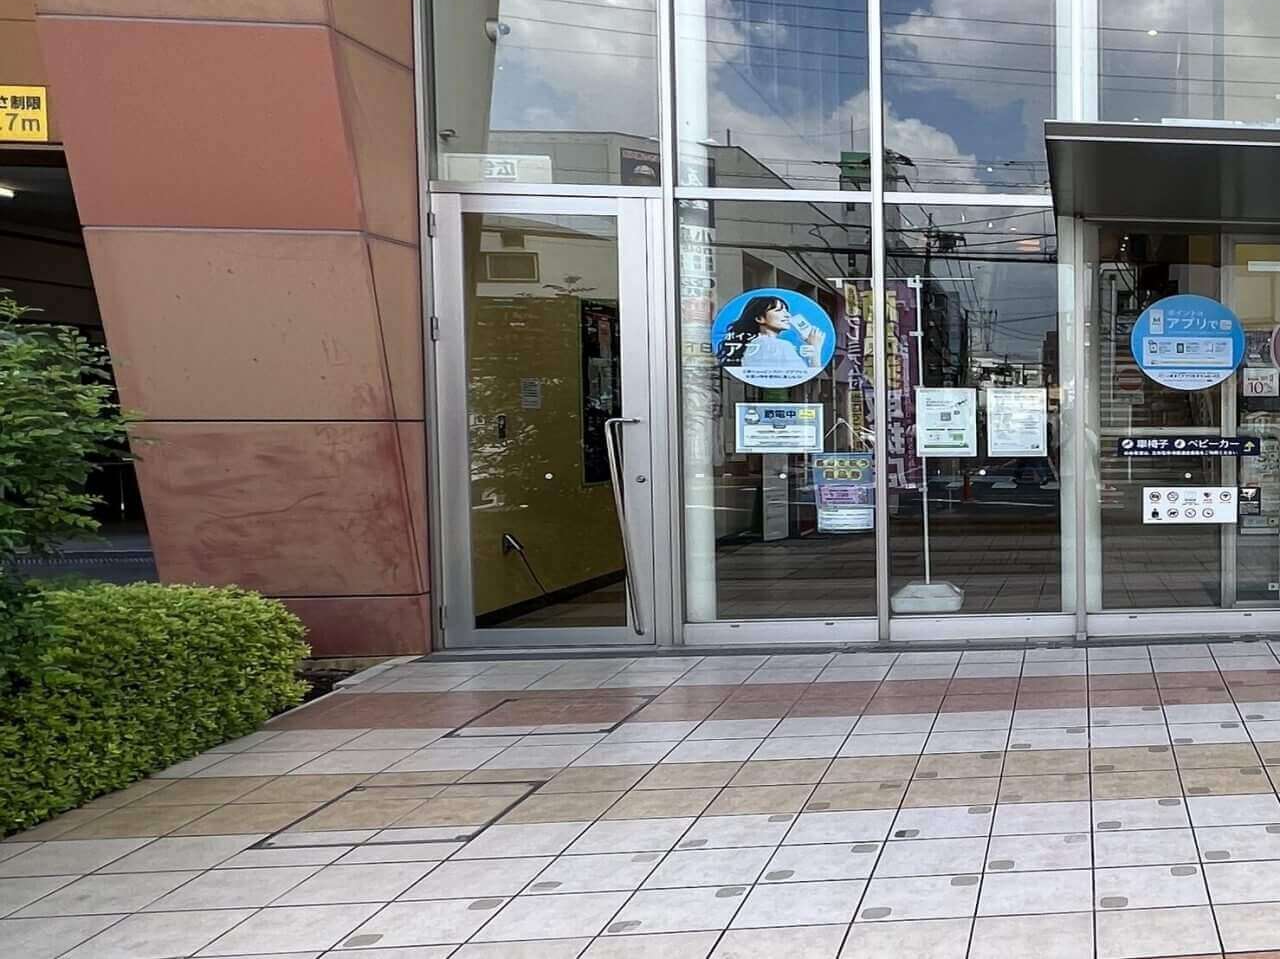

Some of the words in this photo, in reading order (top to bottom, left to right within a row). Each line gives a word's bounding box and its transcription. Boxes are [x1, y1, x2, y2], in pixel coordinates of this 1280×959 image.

[1187, 438, 1241, 449] ベビーカー
